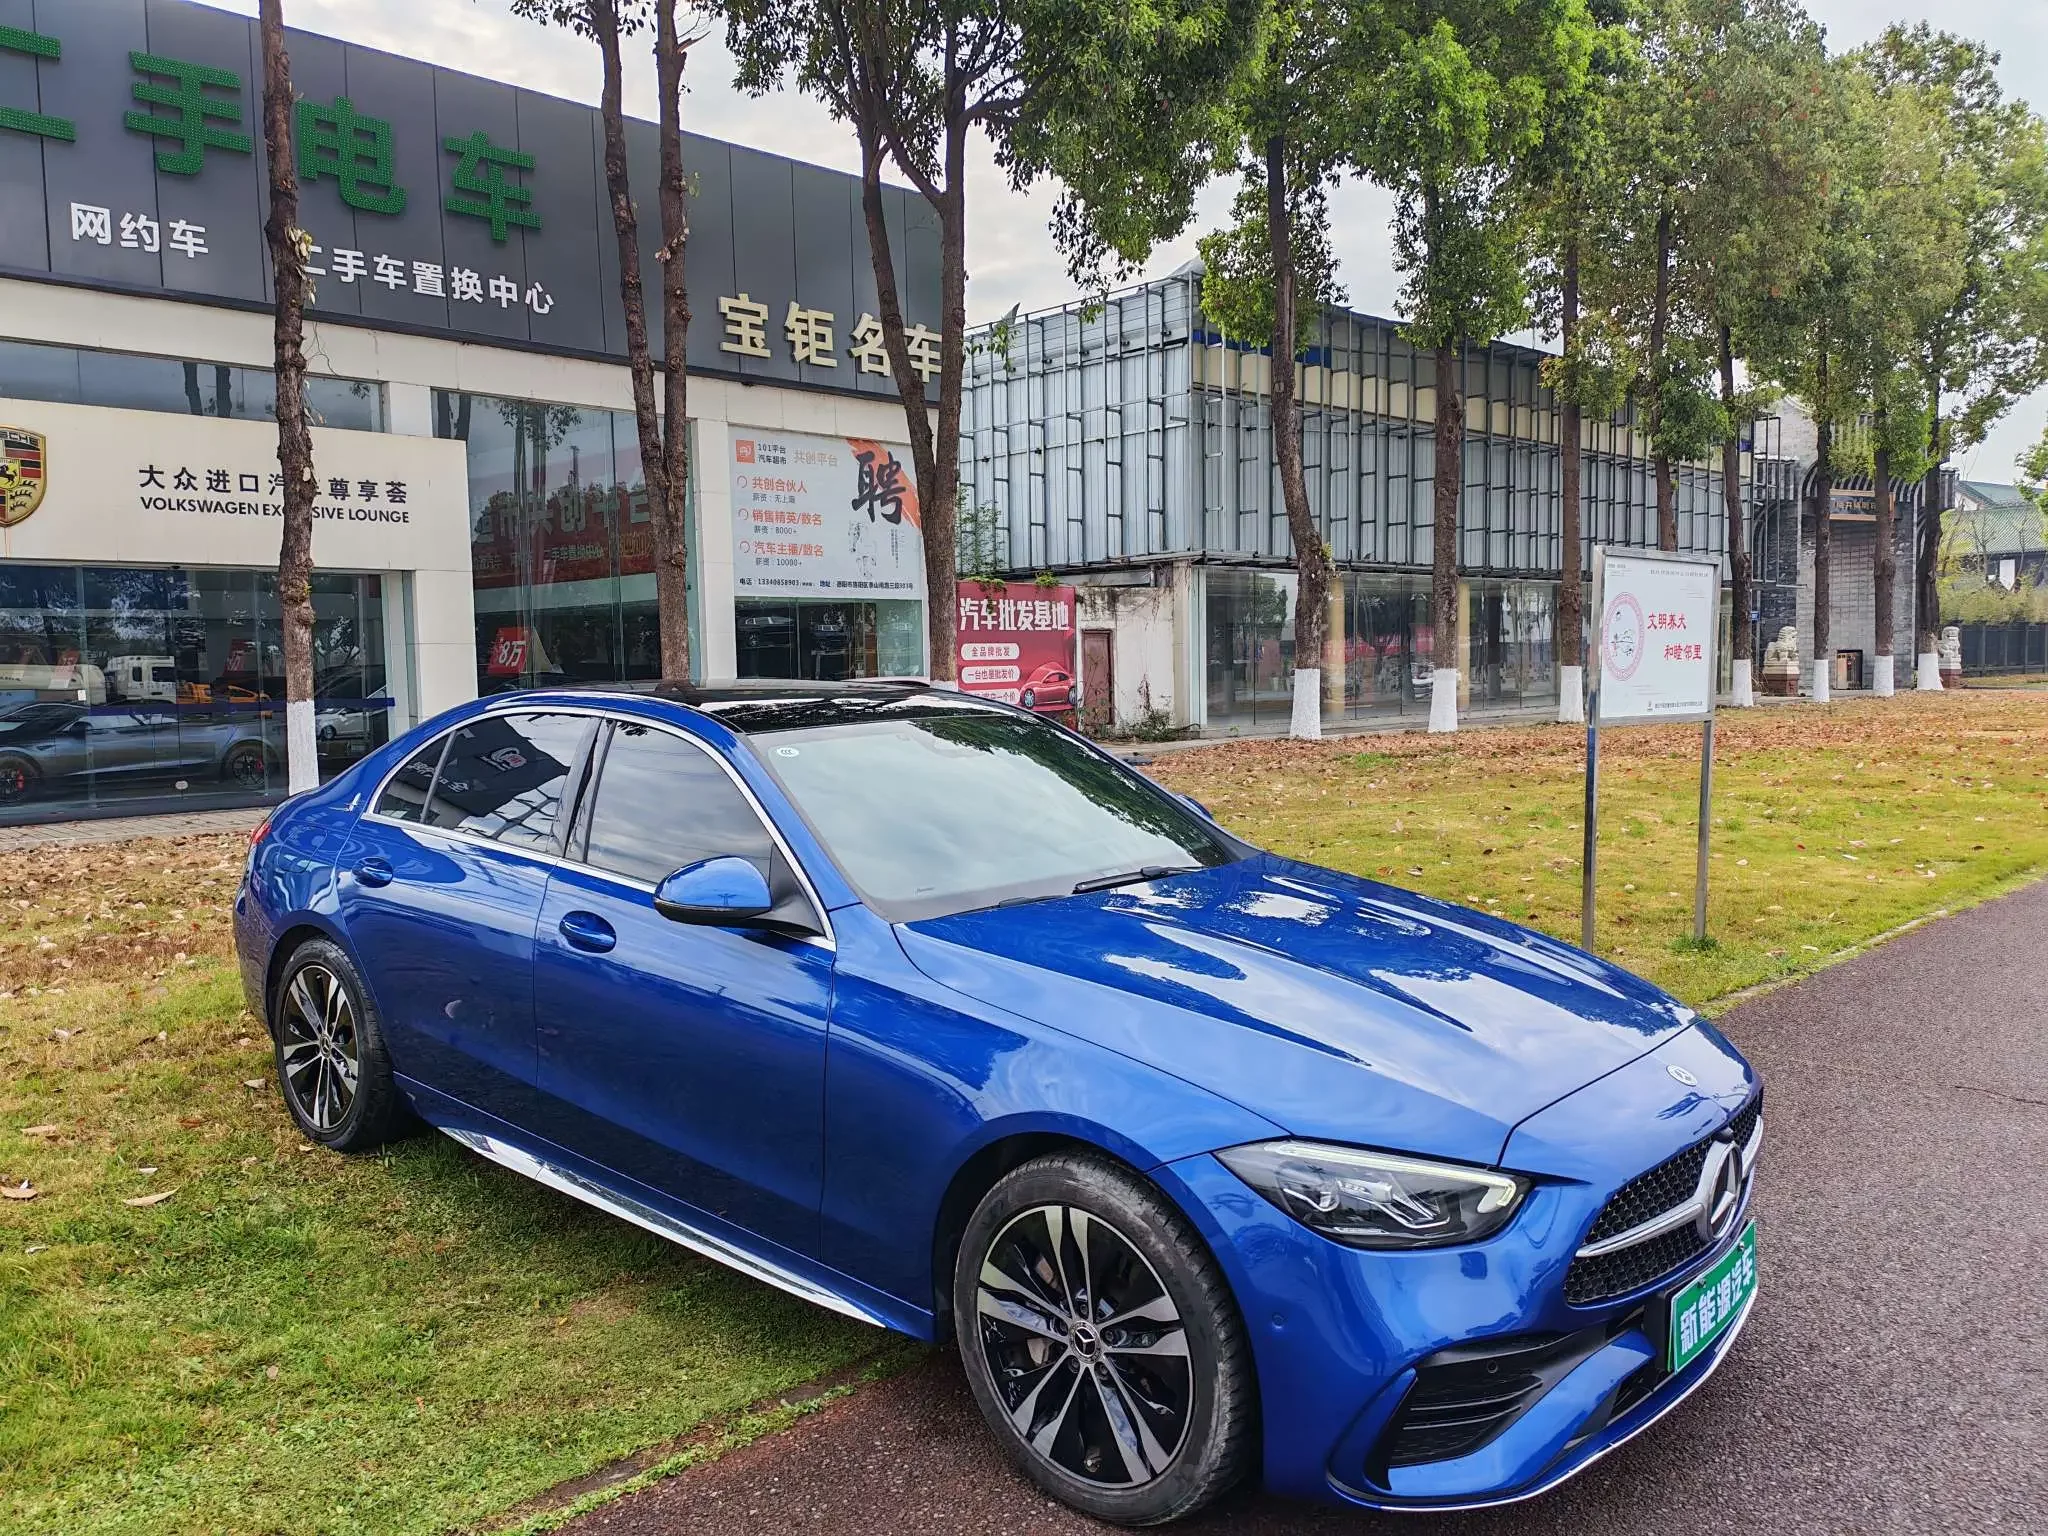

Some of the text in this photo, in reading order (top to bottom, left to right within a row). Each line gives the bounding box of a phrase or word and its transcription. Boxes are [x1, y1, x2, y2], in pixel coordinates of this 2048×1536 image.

[0, 26, 542, 240] 二手电车
[70, 202, 209, 258] 网约车
[304, 245, 555, 315] 二手车置换中心
[718, 294, 942, 382] 宝钜名车
[758, 455, 787, 465] 汽车超市
[793, 449, 838, 467] 共创平台
[139, 464, 407, 504] 大众进口汽尊享荟
[752, 475, 808, 494] 共创合伙人
[852, 451, 906, 525] 聘
[140, 496, 409, 523] VOLKSWAGEN EXSIVE LOUNGE
[752, 509, 822, 526] 销售精英/数名
[753, 541, 825, 558] 汽车主播/数名
[960, 598, 1069, 631] 汽车批发基地
[971, 646, 1010, 657] 全品牌批发
[1664, 643, 1703, 661] 和睦邻里
[1680, 1244, 1753, 1356] 新能源汽车
